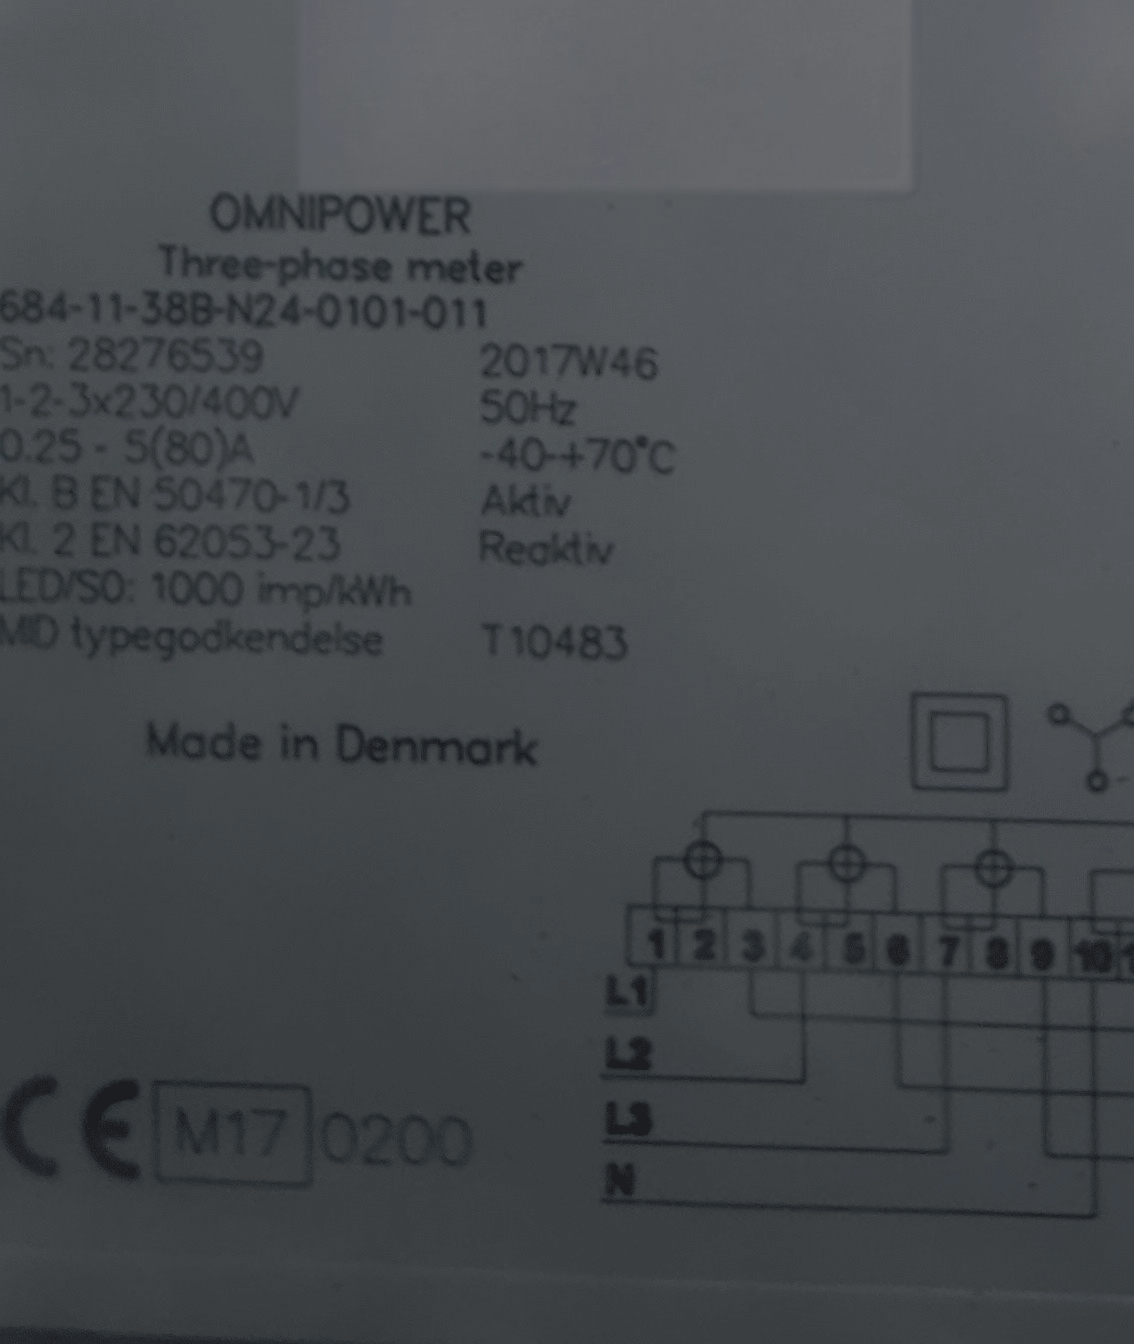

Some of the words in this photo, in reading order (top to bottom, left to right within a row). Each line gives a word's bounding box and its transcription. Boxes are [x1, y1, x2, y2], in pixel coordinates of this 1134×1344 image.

[208, 190, 473, 236] OMNIPOWER
[156, 241, 393, 289] Three-phase
[406, 248, 525, 285] meter
[0, 286, 487, 330] 684-11-38B-N24-0101-011
[0, 335, 54, 371] Sn:
[67, 335, 264, 374] 28276539
[479, 340, 660, 382] 2017W46
[0, 379, 301, 421] 1-2-3x230/400V
[479, 387, 579, 427] 50Hz
[0, 427, 83, 464] 0.25
[124, 424, 257, 473] 5(80)A
[52, 474, 80, 512] B
[91, 474, 142, 511] EN
[153, 476, 351, 515] 50470-1/3
[480, 482, 573, 518] Aktiv
[52, 520, 77, 559] 2
[91, 522, 142, 559] EN
[153, 523, 343, 563] 62053-23
[478, 528, 615, 567] Reaktiv
[152, 569, 245, 608] 1000
[256, 570, 413, 613] imp/kWh
[70, 614, 384, 663] typegodkendelse
[145, 719, 263, 763] Made
[279, 721, 320, 762] in
[336, 722, 541, 768] Denmark
[647, 927, 666, 961] 1
[692, 928, 717, 962] 2
[741, 928, 766, 963] 3
[789, 930, 814, 962] 4
[842, 931, 866, 965] 5
[938, 934, 961, 968] 7
[985, 936, 1009, 971] 8
[1029, 937, 1056, 972] 9
[1074, 938, 1113, 974] 10
[605, 974, 647, 1007] L1
[605, 1036, 653, 1071] L2
[174, 1107, 289, 1158] M17
[319, 1111, 475, 1169] 0200
[605, 1101, 653, 1137] L3
[605, 1162, 636, 1197] N
